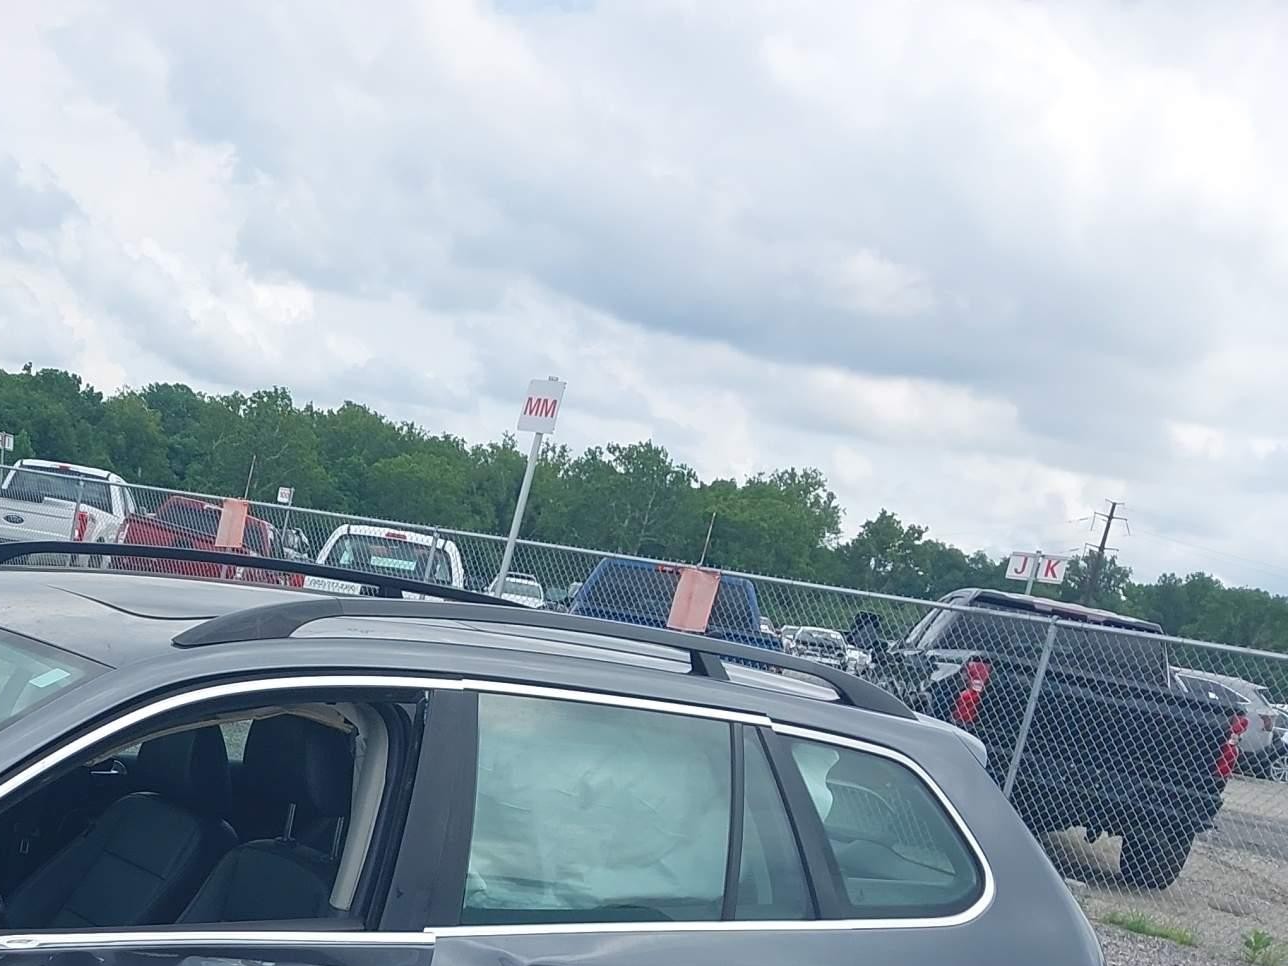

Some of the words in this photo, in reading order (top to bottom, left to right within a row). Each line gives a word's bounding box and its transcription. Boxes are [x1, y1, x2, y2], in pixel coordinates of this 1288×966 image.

[523, 396, 557, 419] MM
[1014, 556, 1028, 575] J
[1044, 559, 1062, 579] K
